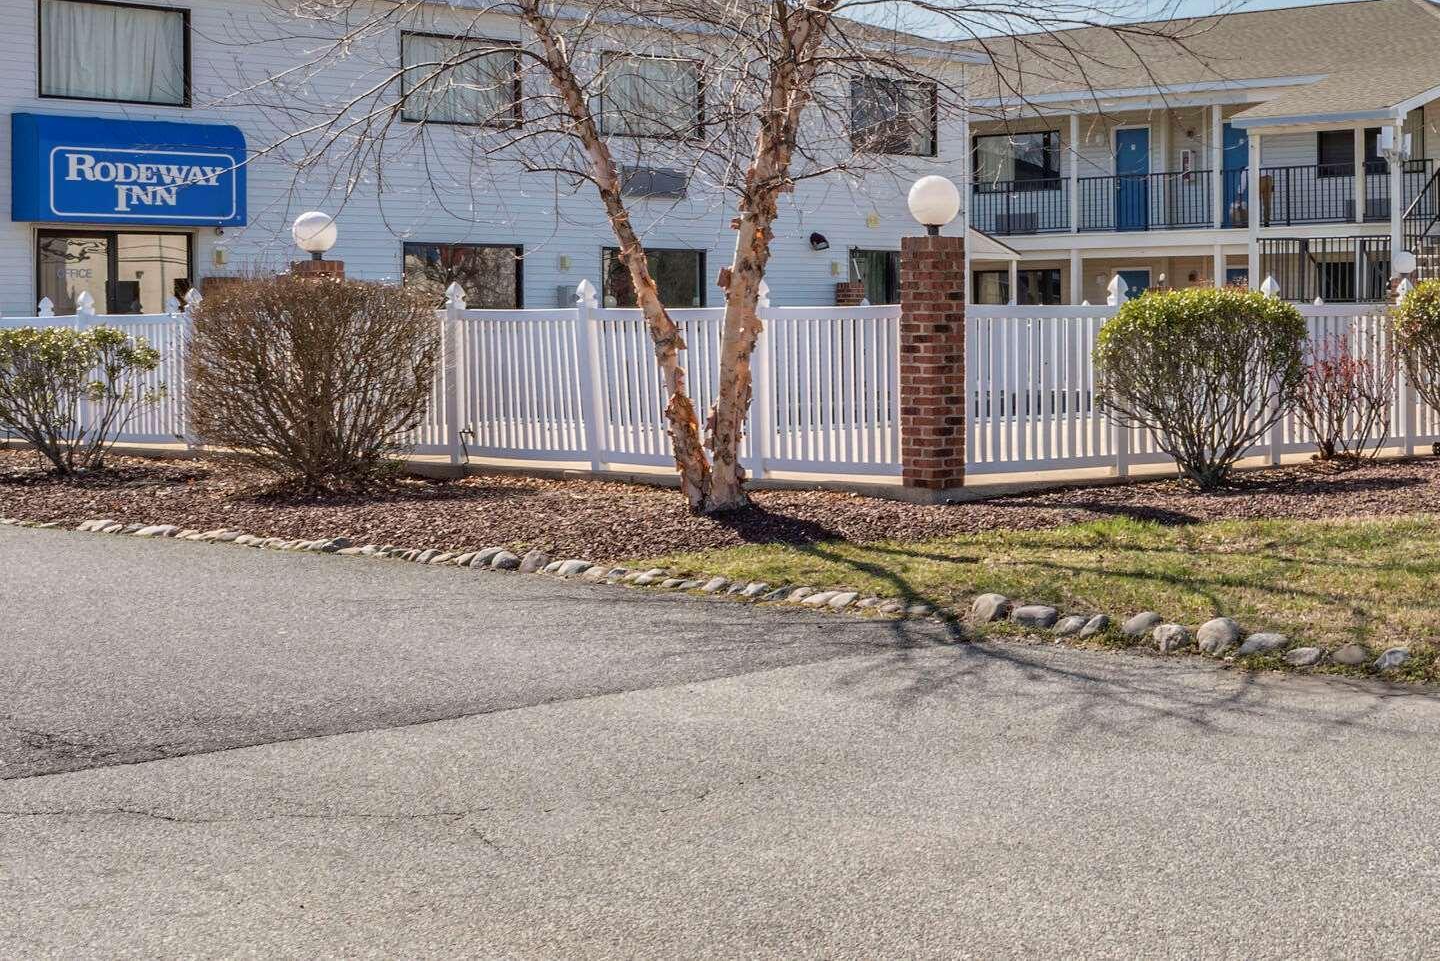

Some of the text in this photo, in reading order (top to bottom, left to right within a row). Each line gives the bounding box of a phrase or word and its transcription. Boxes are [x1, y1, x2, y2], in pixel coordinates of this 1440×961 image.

[64, 153, 224, 186] RODEWAY
[113, 184, 177, 211] INN
[56, 268, 93, 279] OFFICE
